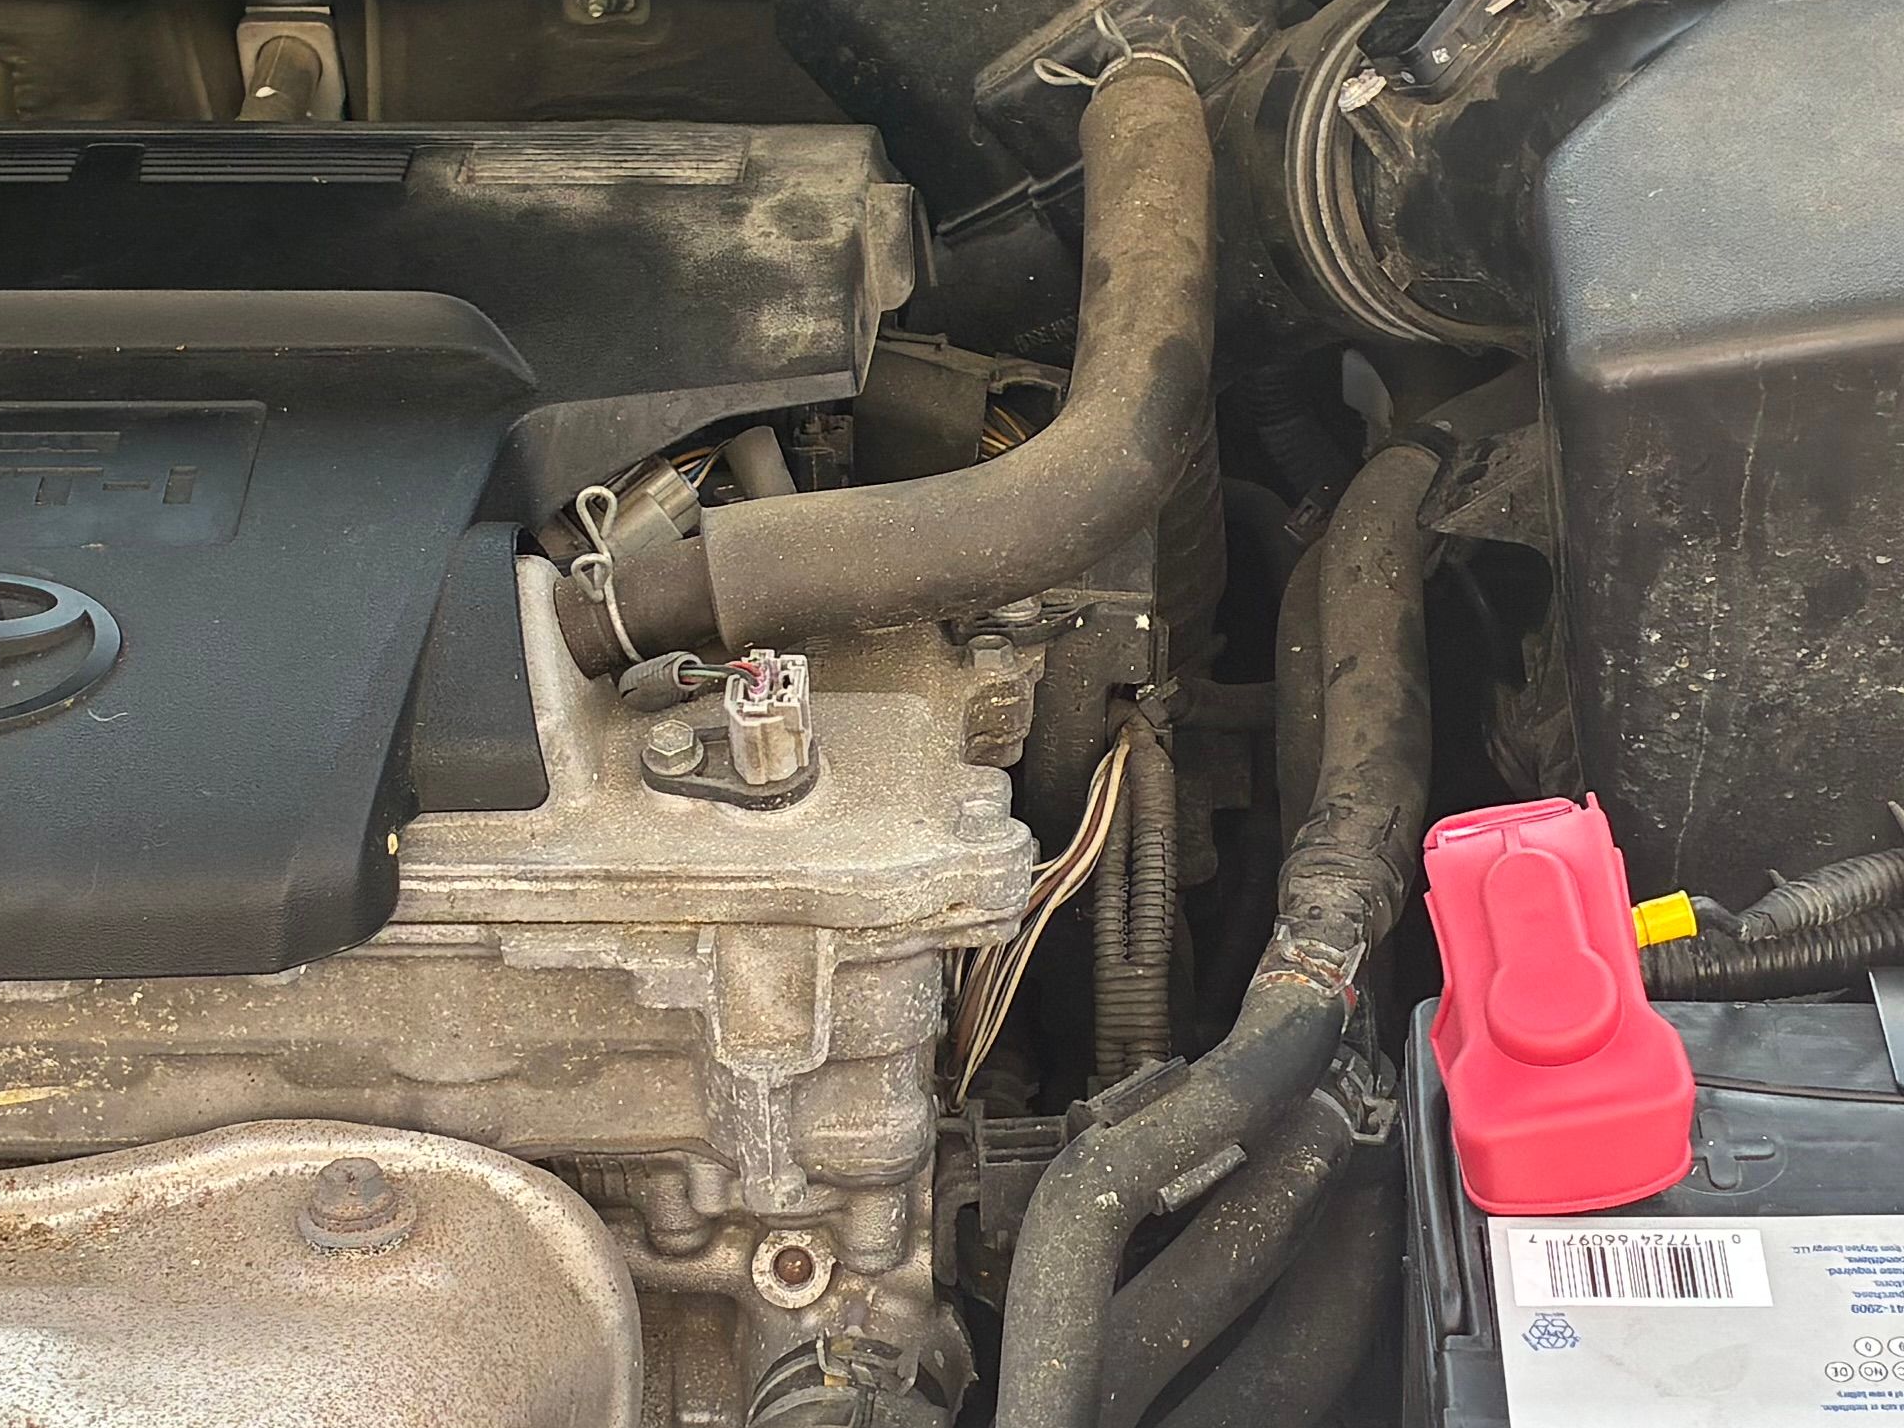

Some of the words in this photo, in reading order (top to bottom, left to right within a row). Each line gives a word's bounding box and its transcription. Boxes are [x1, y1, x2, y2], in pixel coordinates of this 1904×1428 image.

[1528, 1234, 1536, 1243] 7
[1566, 1234, 1627, 1246] 66097
[1640, 1234, 1700, 1246] 17724
[1830, 1367, 1846, 1376] DE
